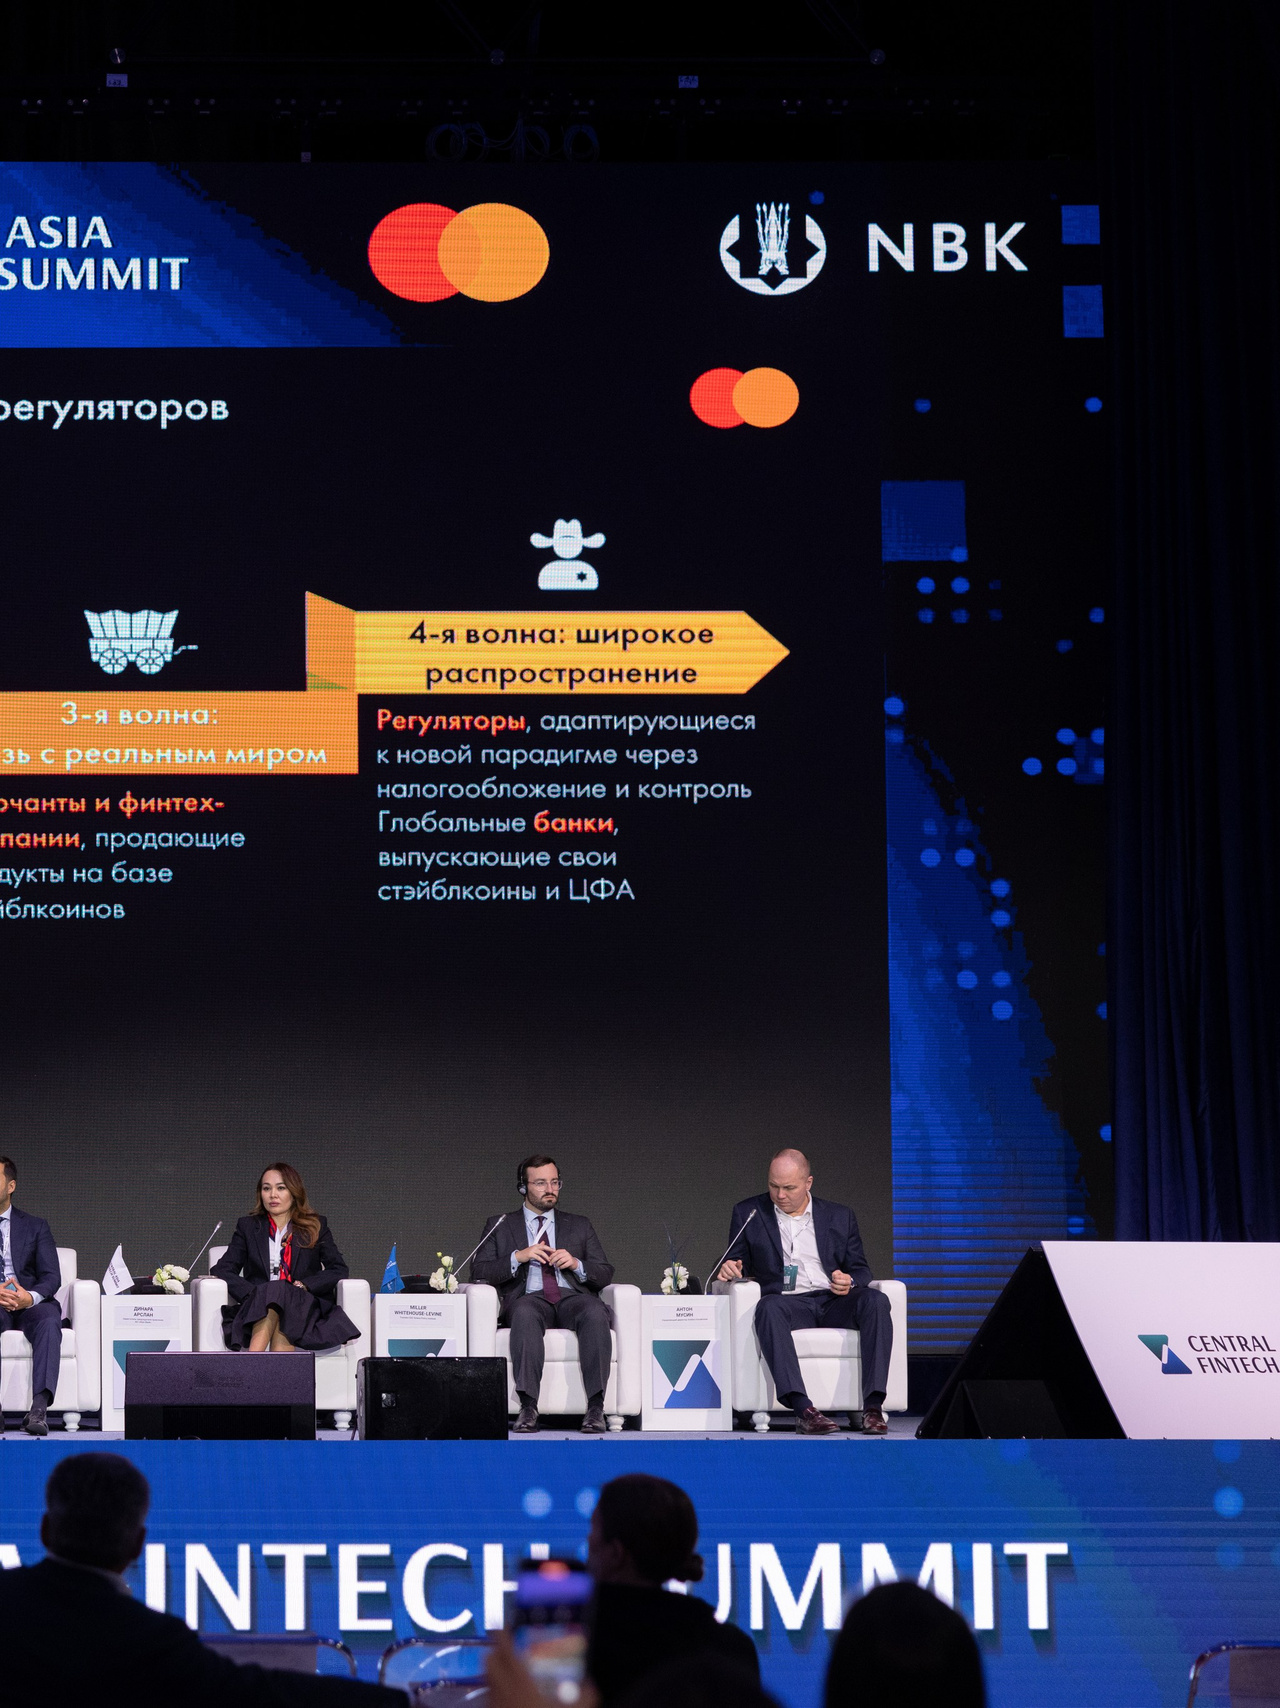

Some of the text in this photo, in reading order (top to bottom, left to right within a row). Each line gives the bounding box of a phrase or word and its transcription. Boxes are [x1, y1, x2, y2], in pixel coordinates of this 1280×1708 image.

[5, 215, 113, 249] ASIA
[868, 222, 1028, 272] NBK
[408, 620, 714, 652] 4-я волна: широкое
[426, 667, 697, 691] распространение
[61, 700, 218, 725] 3-я волна:
[377, 708, 756, 737] Регуляторы, адаптирующиеся
[40, 748, 56, 765] с
[65, 747, 217, 771] реальным
[225, 748, 328, 771] миром
[377, 744, 699, 770] к новой парадигме через
[377, 775, 752, 805] налогообложение и контроль
[95, 797, 110, 813] и
[118, 790, 225, 820] финтех-
[378, 809, 619, 836] Глобальные банки,
[95, 832, 246, 853] продающие
[73, 867, 103, 883] на
[111, 860, 173, 883] базе
[378, 851, 617, 873] выпускающие свои
[377, 877, 635, 904] стэйблкоины и ЦФА
[1187, 1335, 1277, 1353] CENTRAL
[1196, 1356, 1280, 1374] FINTECH
[144, 1542, 551, 1633] INTECH
